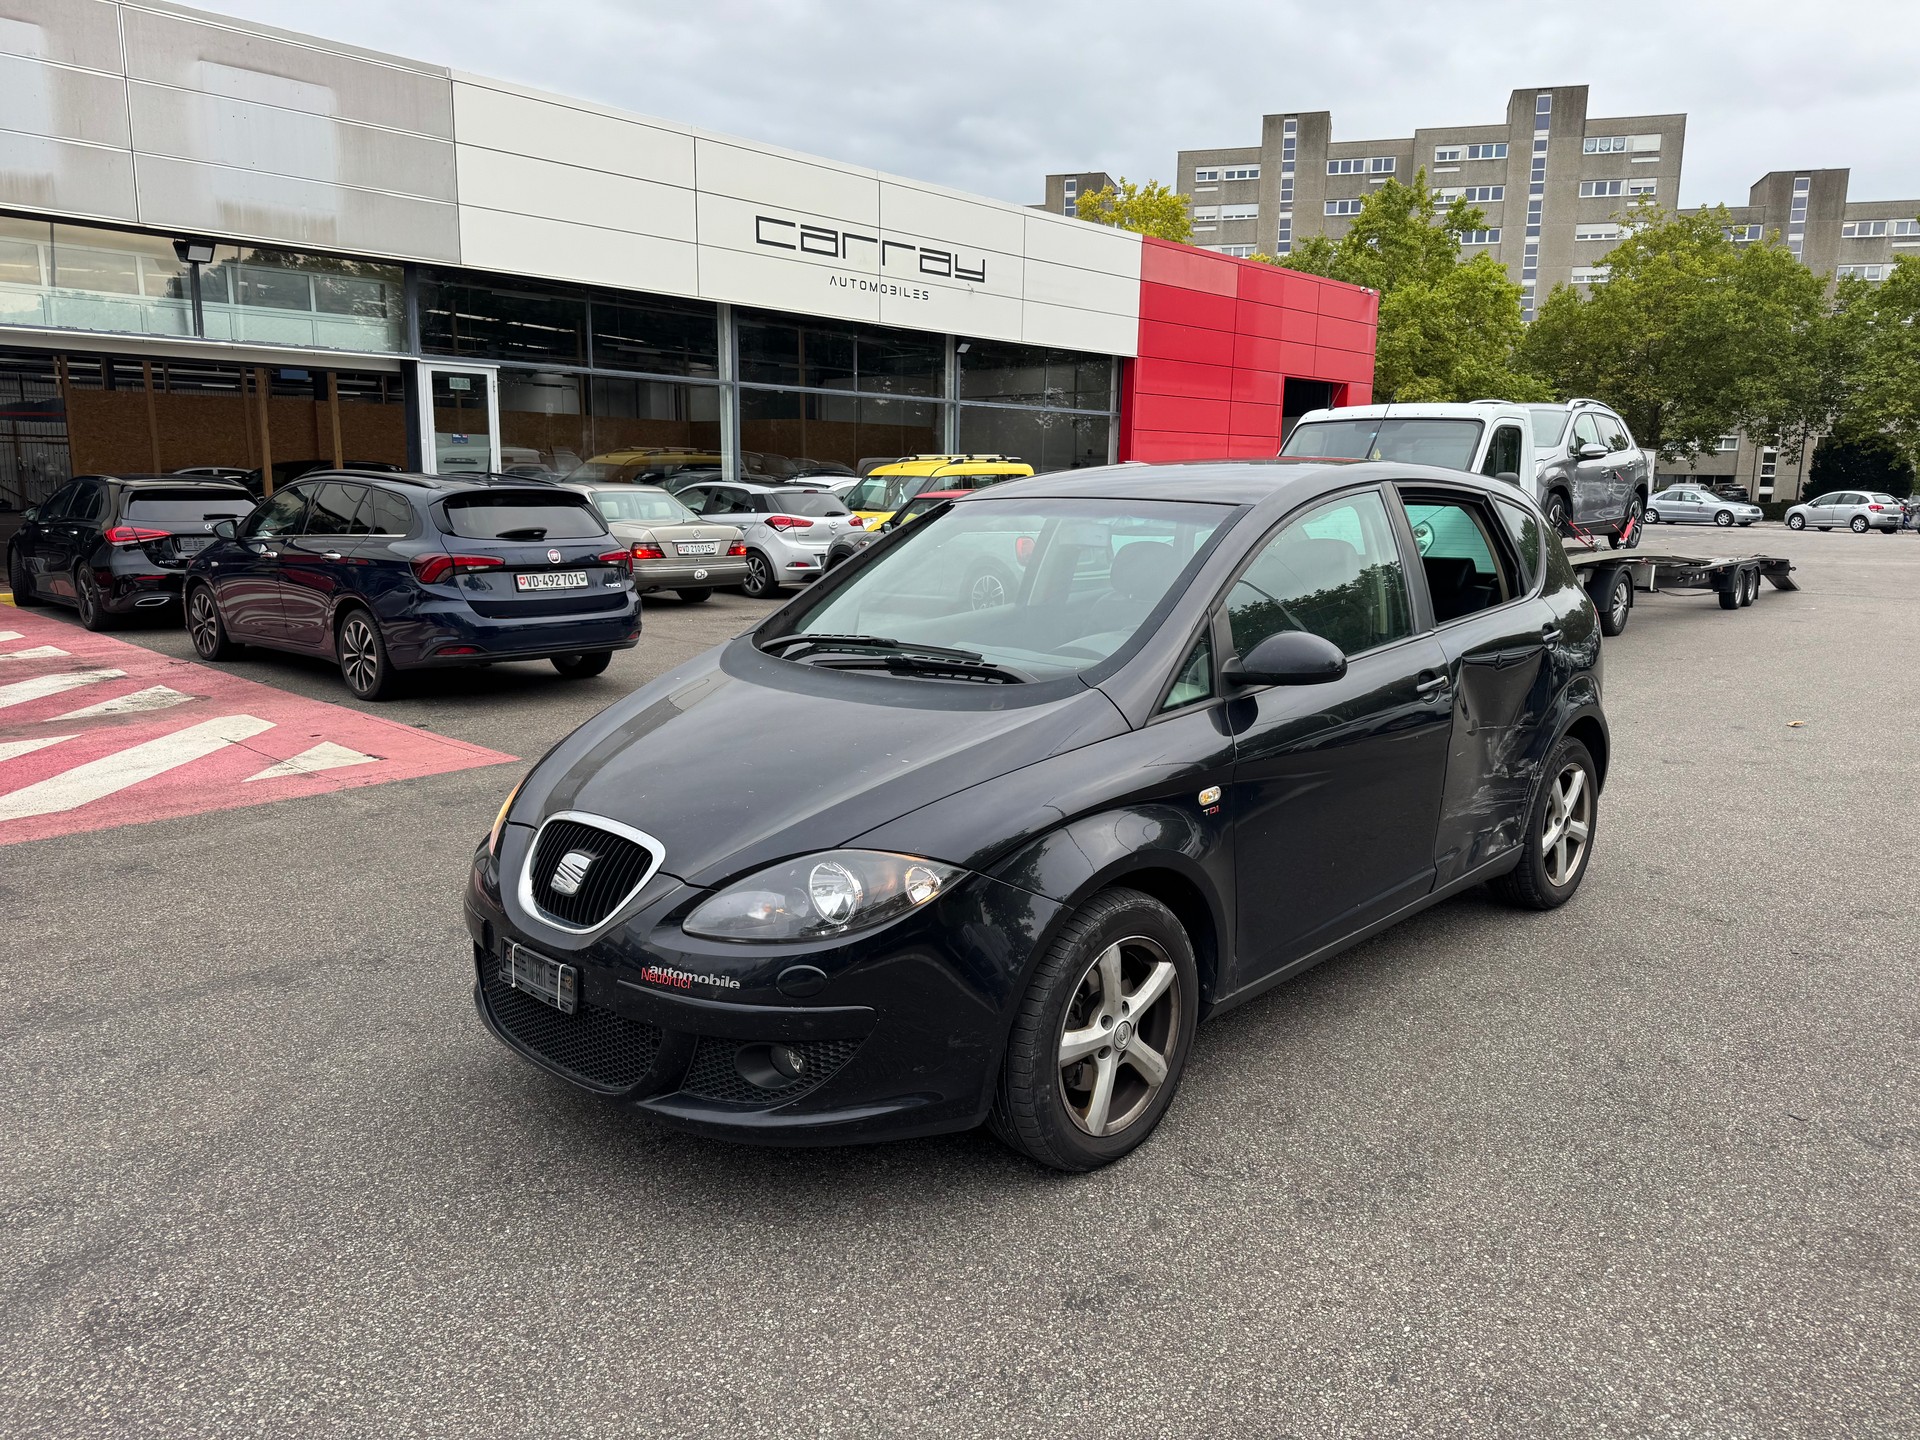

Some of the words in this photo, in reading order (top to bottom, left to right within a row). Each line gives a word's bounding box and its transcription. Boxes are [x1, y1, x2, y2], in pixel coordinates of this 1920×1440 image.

[756, 215, 986, 284] carray
[829, 275, 930, 302] AUTOMOBILES
[1203, 804, 1219, 816] TDI
[650, 965, 741, 990] automobile
